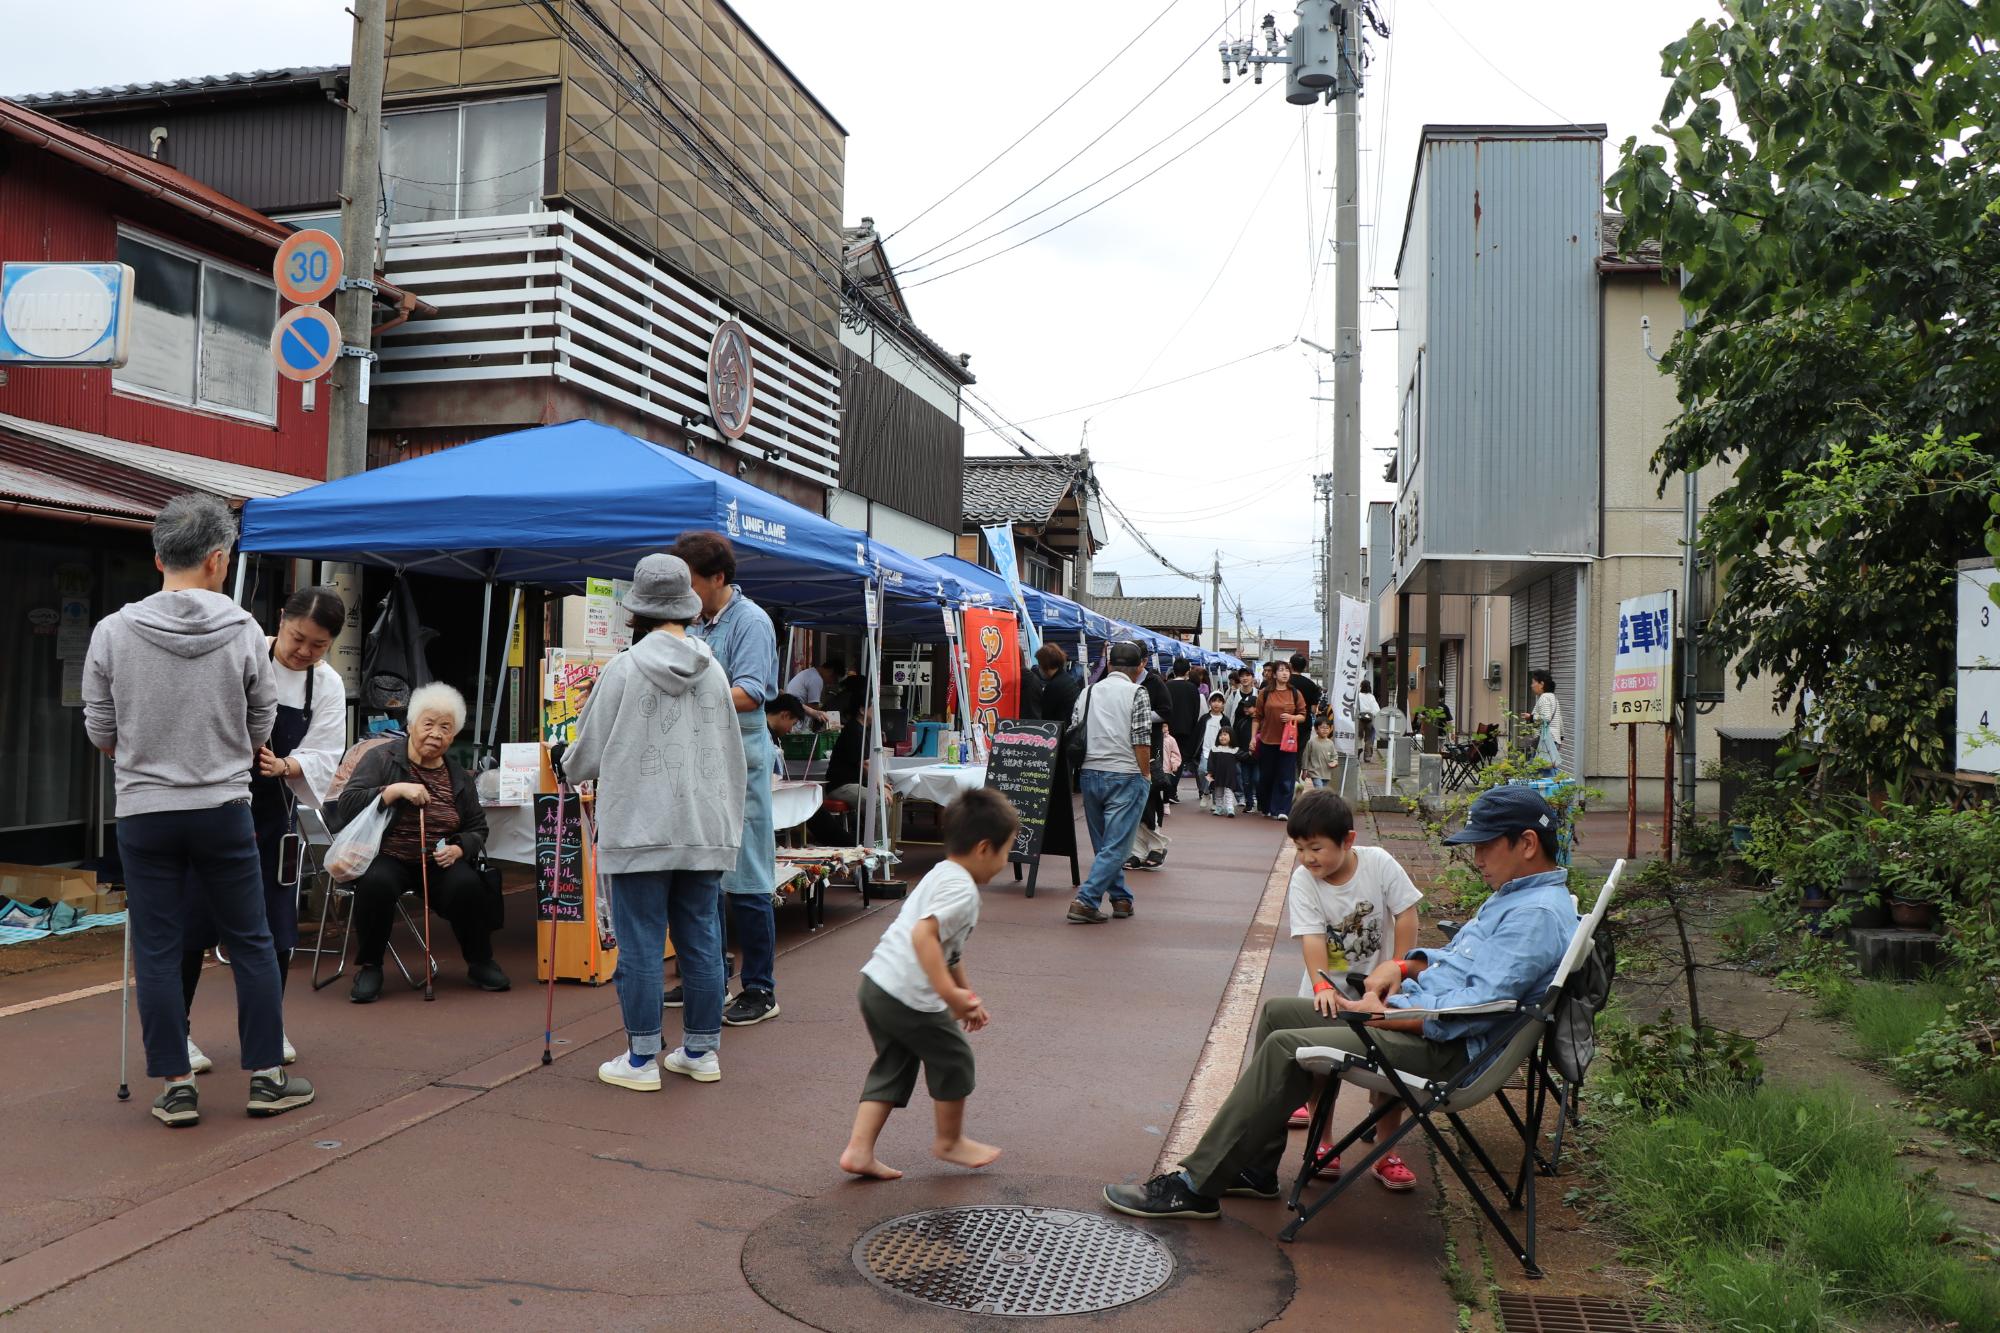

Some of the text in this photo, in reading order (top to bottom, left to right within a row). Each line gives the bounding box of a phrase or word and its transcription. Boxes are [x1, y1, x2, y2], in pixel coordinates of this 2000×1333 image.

[290, 251, 328, 283] 30
[741, 514, 786, 540] UNIFLAME
[1981, 606, 1990, 628] 3
[1980, 710, 1990, 728] 4
